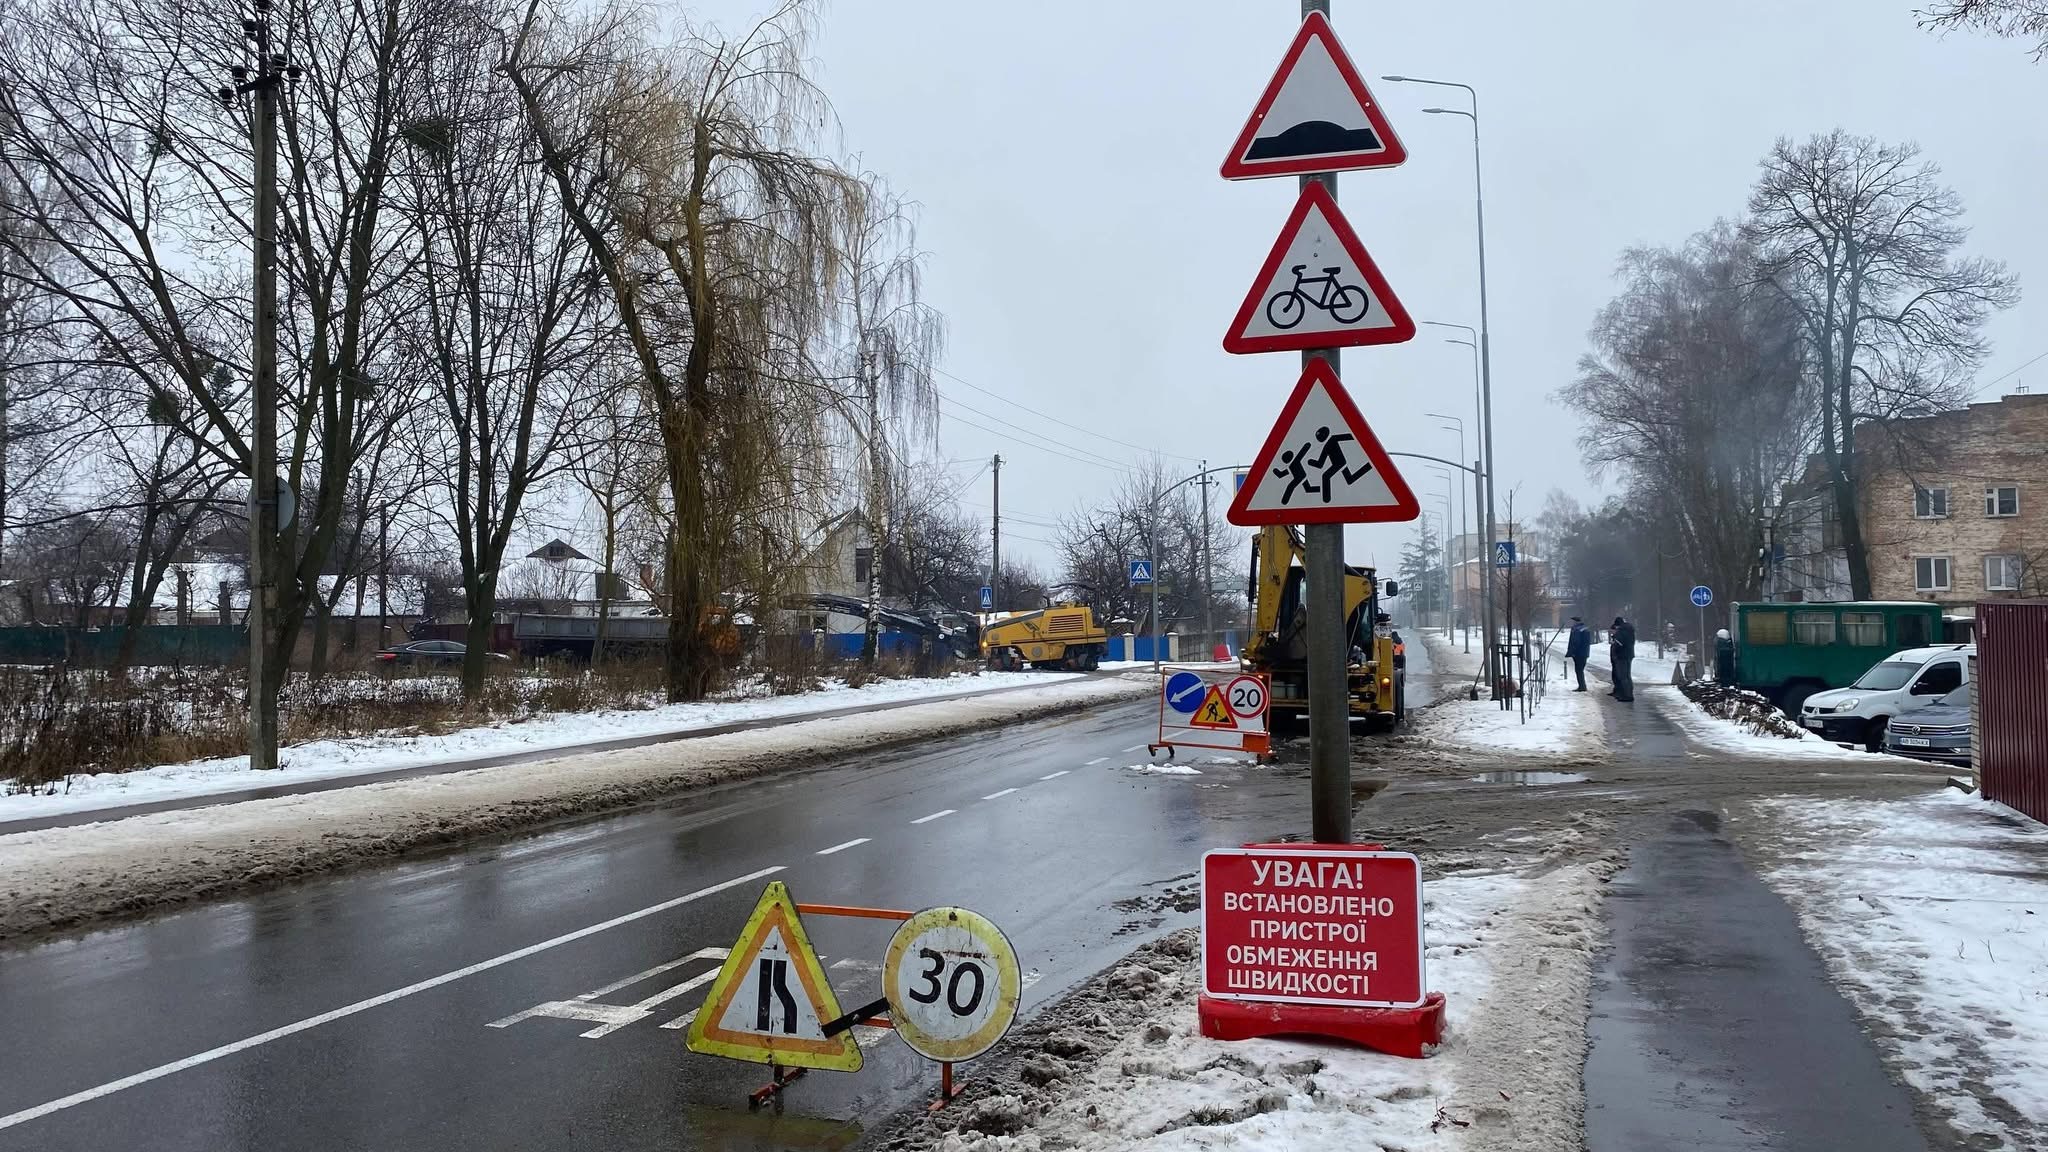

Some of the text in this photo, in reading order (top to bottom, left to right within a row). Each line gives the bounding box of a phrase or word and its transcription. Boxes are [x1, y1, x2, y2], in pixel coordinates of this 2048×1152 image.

[1233, 688, 1260, 707] 20
[1252, 860, 1363, 889] УВАГА!
[1225, 892, 1393, 916] ВСТАНОВЛЕНО
[1251, 920, 1366, 942] ПРИСТРОЇ
[1227, 945, 1377, 970] ОБМЕЖЕННЯ
[909, 948, 984, 1016] 30
[1229, 969, 1368, 995] ШВИДКОСТІ
